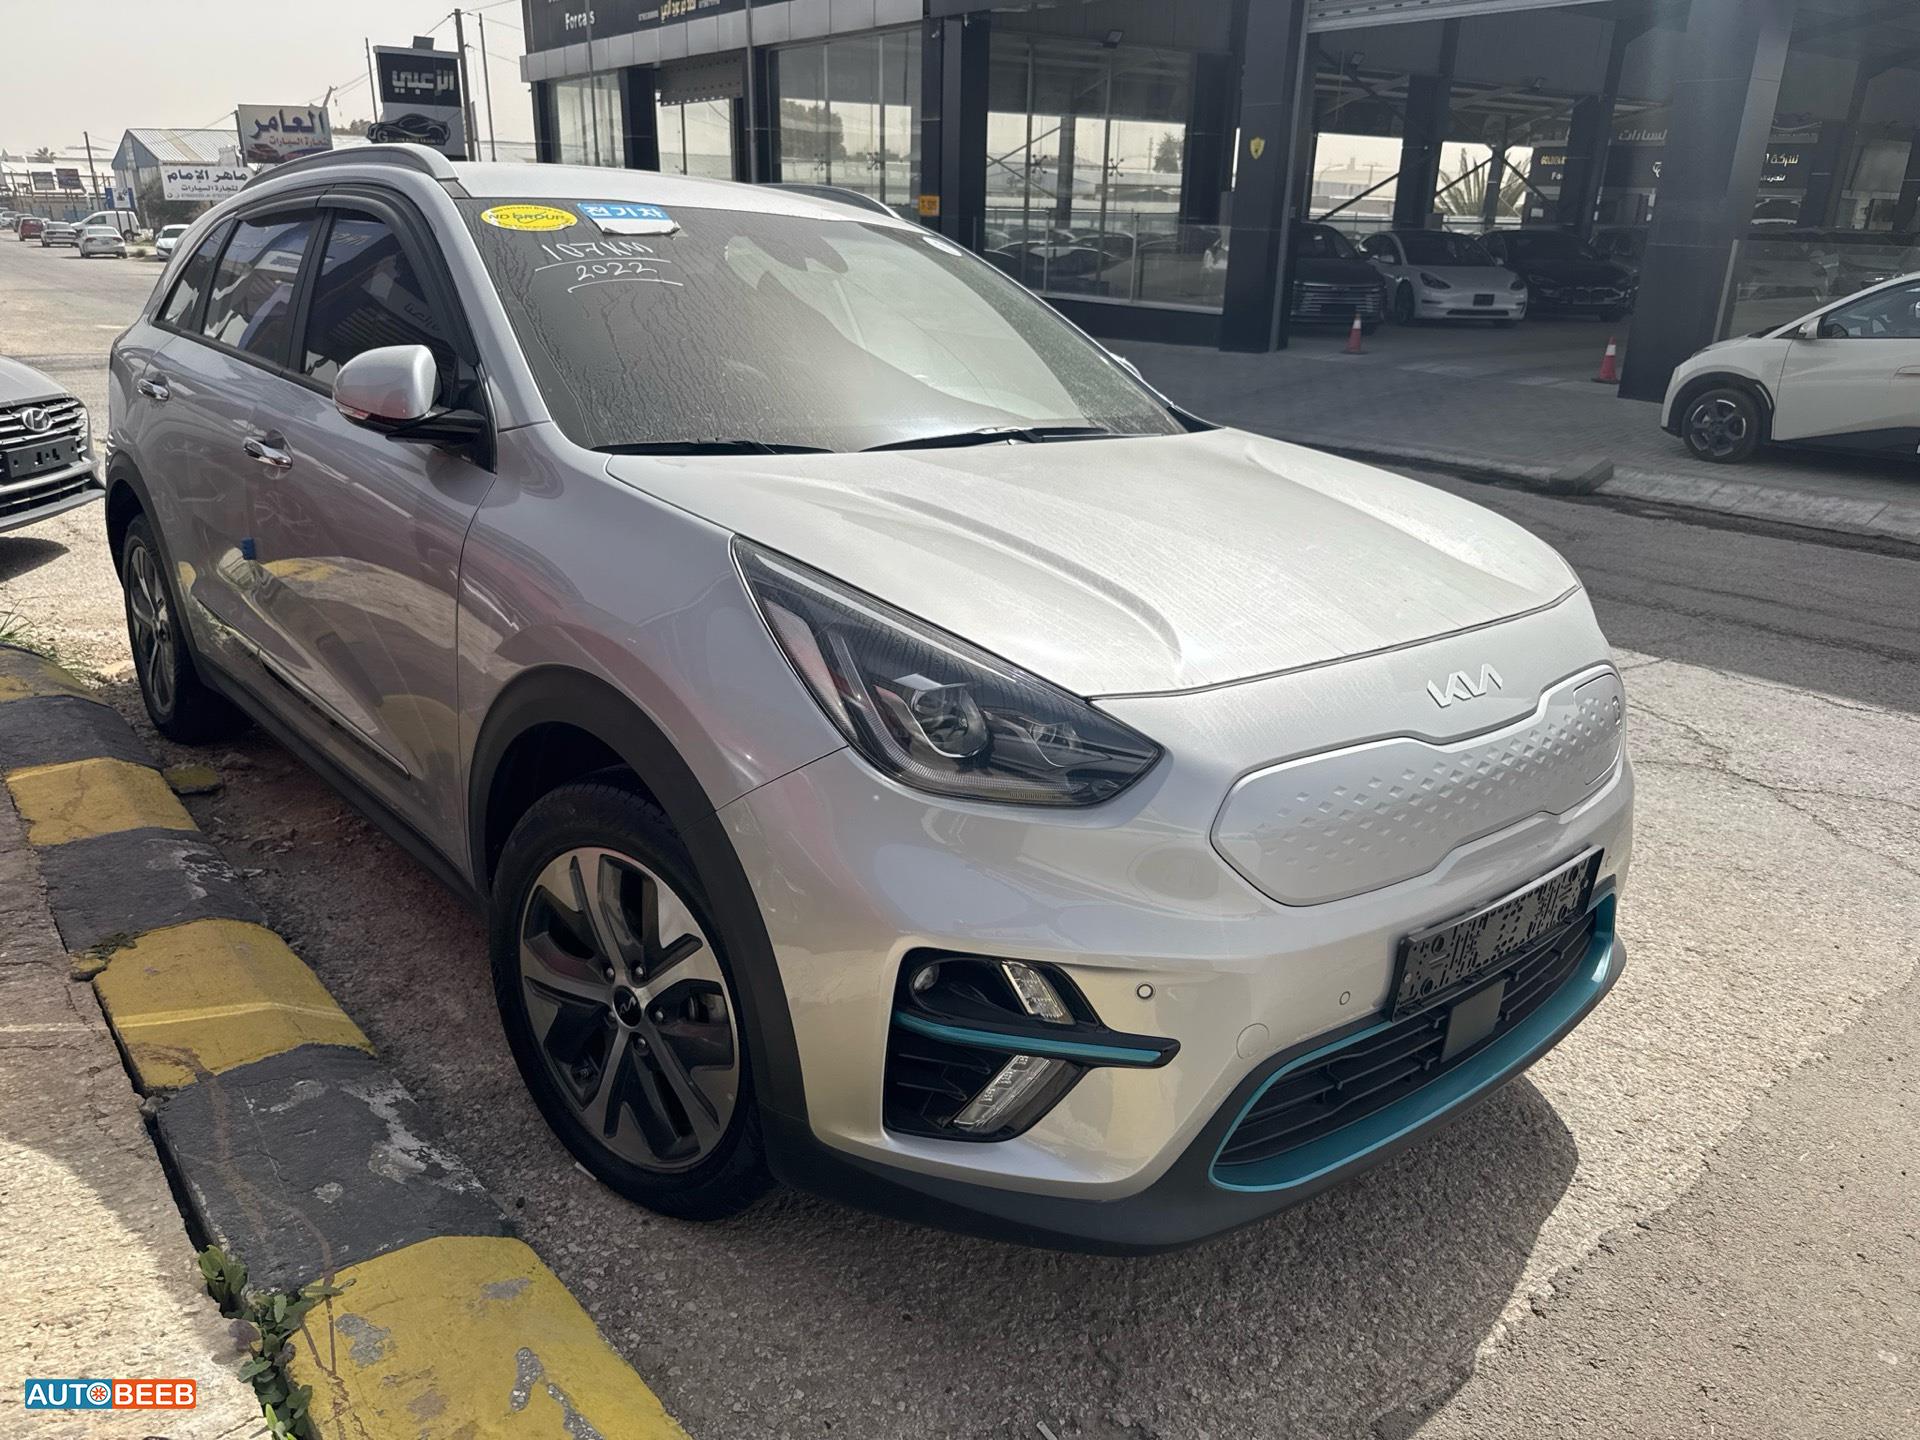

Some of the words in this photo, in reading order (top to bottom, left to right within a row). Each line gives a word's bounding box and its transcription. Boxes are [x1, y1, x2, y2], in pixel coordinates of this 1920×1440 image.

[391, 69, 455, 97] الزعبي
[250, 108, 326, 140] العامر
[213, 168, 248, 183] ماهر
[583, 202, 664, 219] 전기차
[576, 262, 657, 281] 2022
[1427, 662, 1503, 708] KIA
